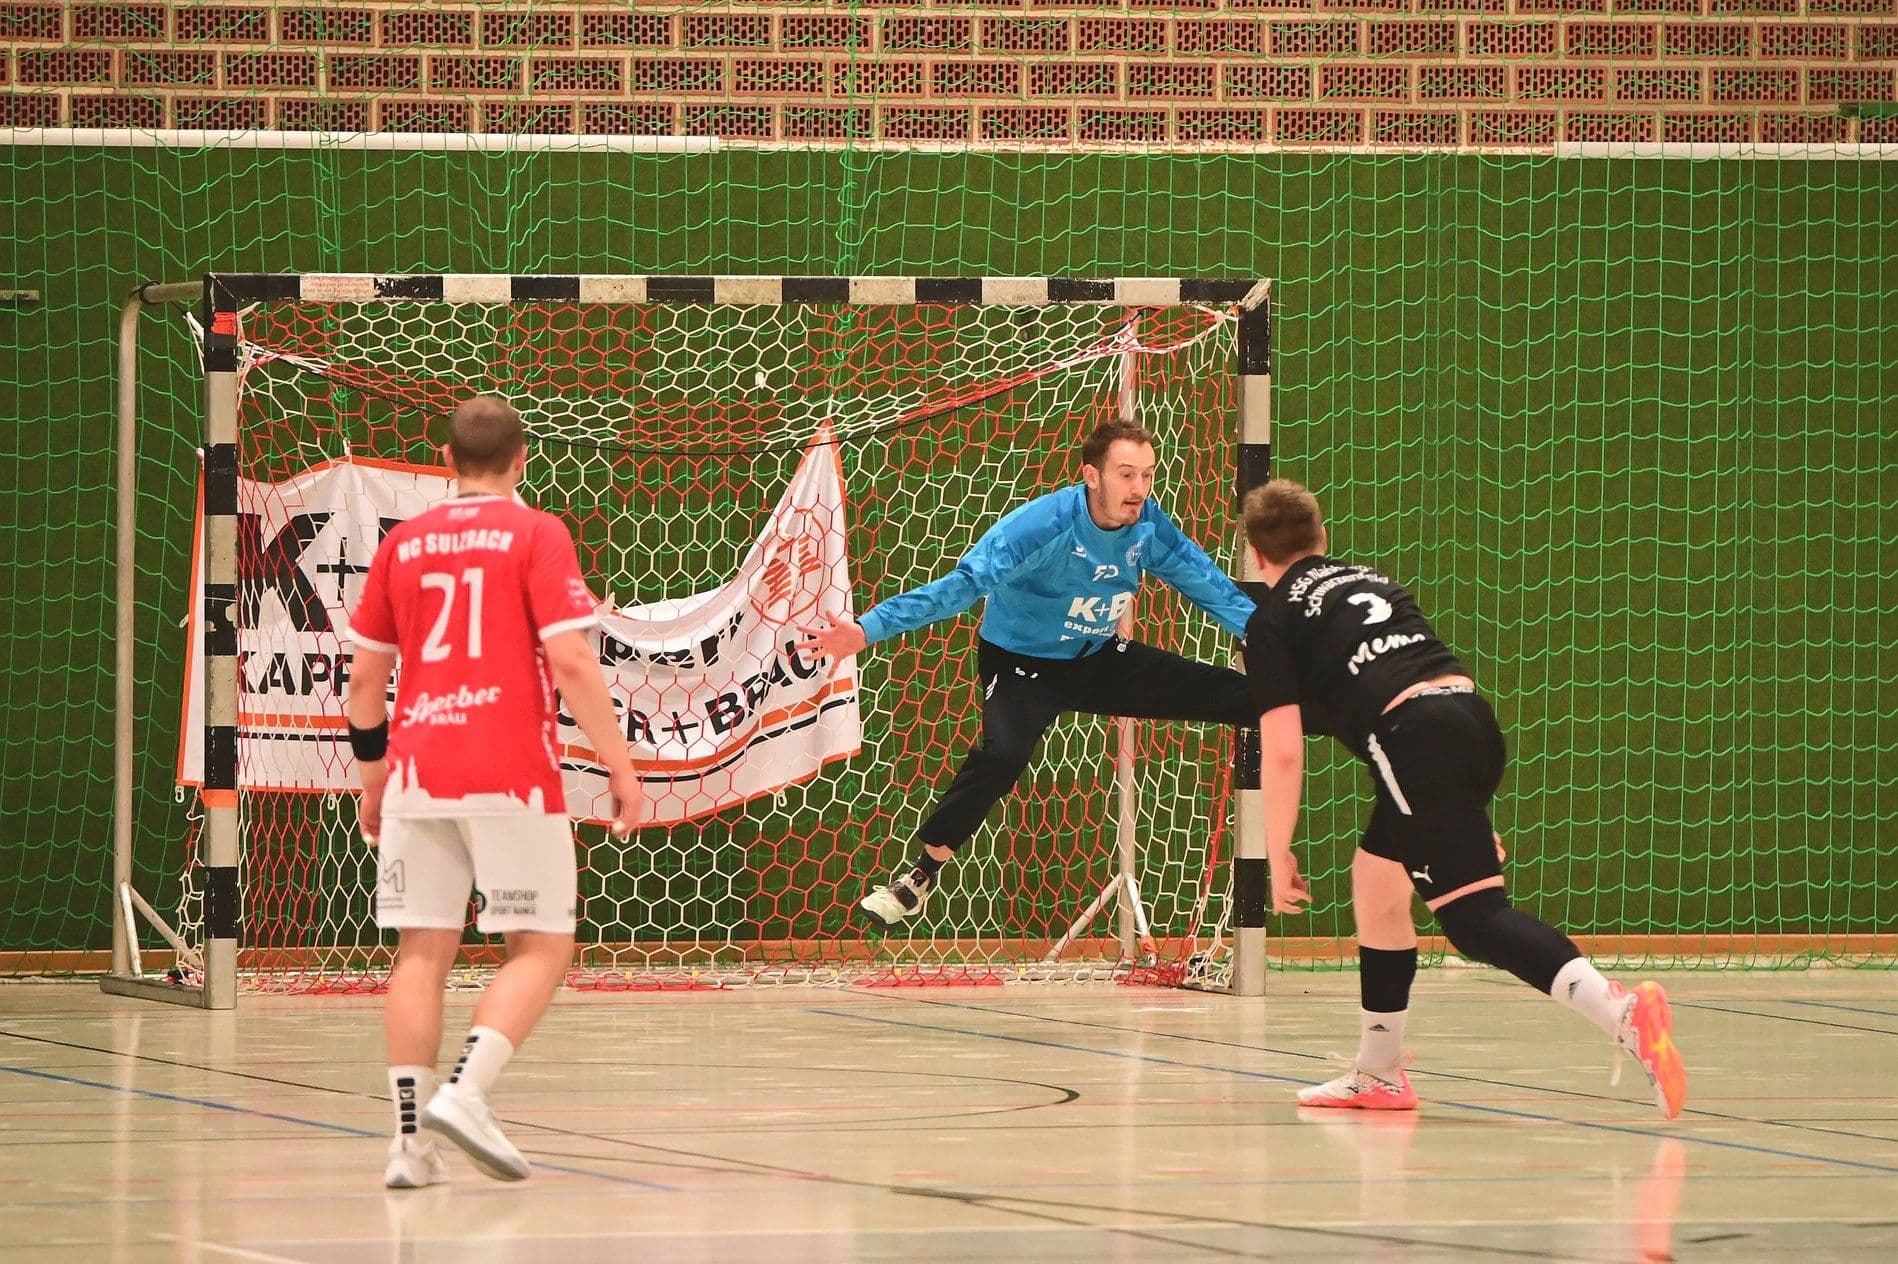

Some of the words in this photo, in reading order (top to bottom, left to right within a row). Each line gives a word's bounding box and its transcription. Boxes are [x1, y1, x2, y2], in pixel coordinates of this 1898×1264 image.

[398, 537, 422, 563] HC
[424, 529, 514, 555] SULZBACH
[1287, 576, 1314, 602] HSG
[420, 567, 484, 663] 21
[1067, 592, 1132, 622] K+B
[1347, 592, 1393, 625] 3
